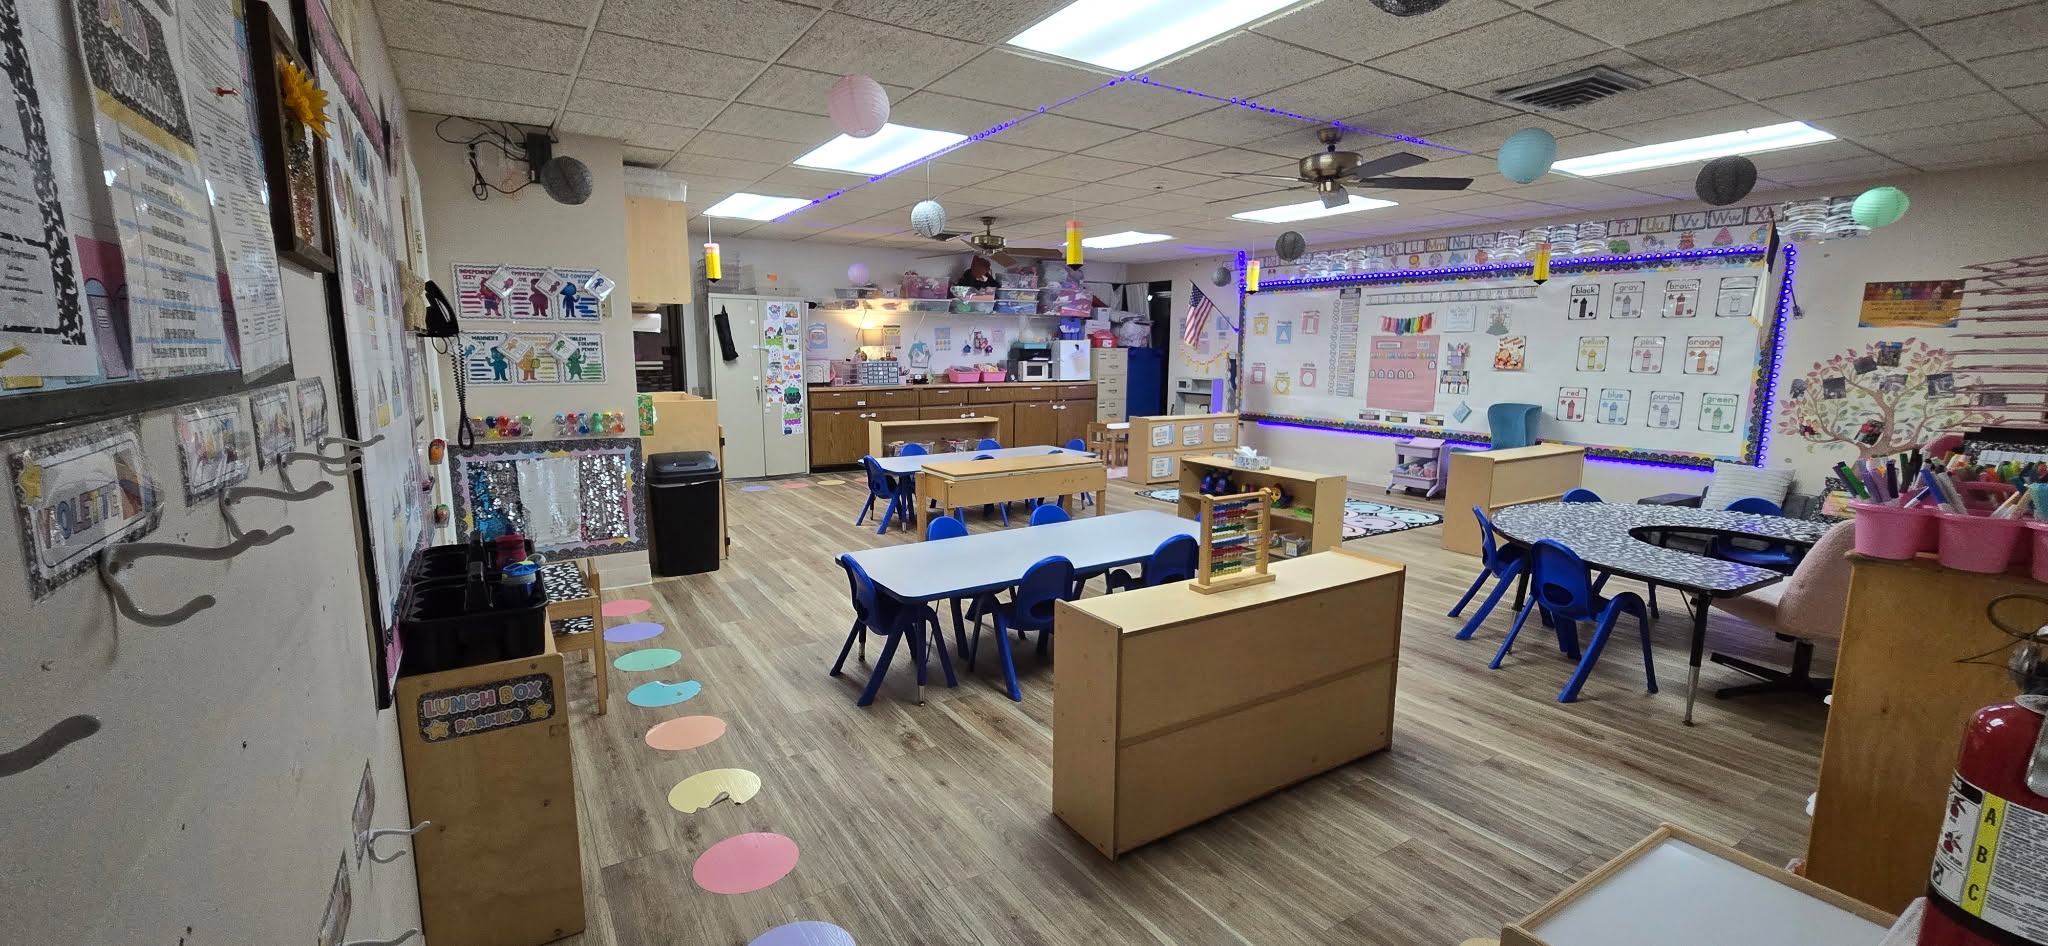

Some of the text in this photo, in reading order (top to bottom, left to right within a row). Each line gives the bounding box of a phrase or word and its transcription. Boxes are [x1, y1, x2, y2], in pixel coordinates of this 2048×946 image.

[1681, 215, 1699, 227] Vv
[1712, 212, 1741, 224] Ww
[1616, 221, 1629, 233] Tt
[1427, 240, 1445, 250] Mm
[1575, 286, 1595, 294] black
[1619, 284, 1638, 293] gray
[1669, 282, 1697, 290] brown
[1582, 338, 1605, 346] yellow
[1688, 339, 1720, 347] orange
[1566, 389, 1580, 397] red
[1607, 391, 1623, 399] blue
[1652, 393, 1680, 402] purple
[37, 484, 120, 549] VOLETTE
[423, 680, 542, 718] LUNCH BOX
[455, 708, 524, 733] PARKING
[1984, 808, 1996, 826] A
[1976, 845, 1988, 864] B
[1968, 883, 1979, 901] C
